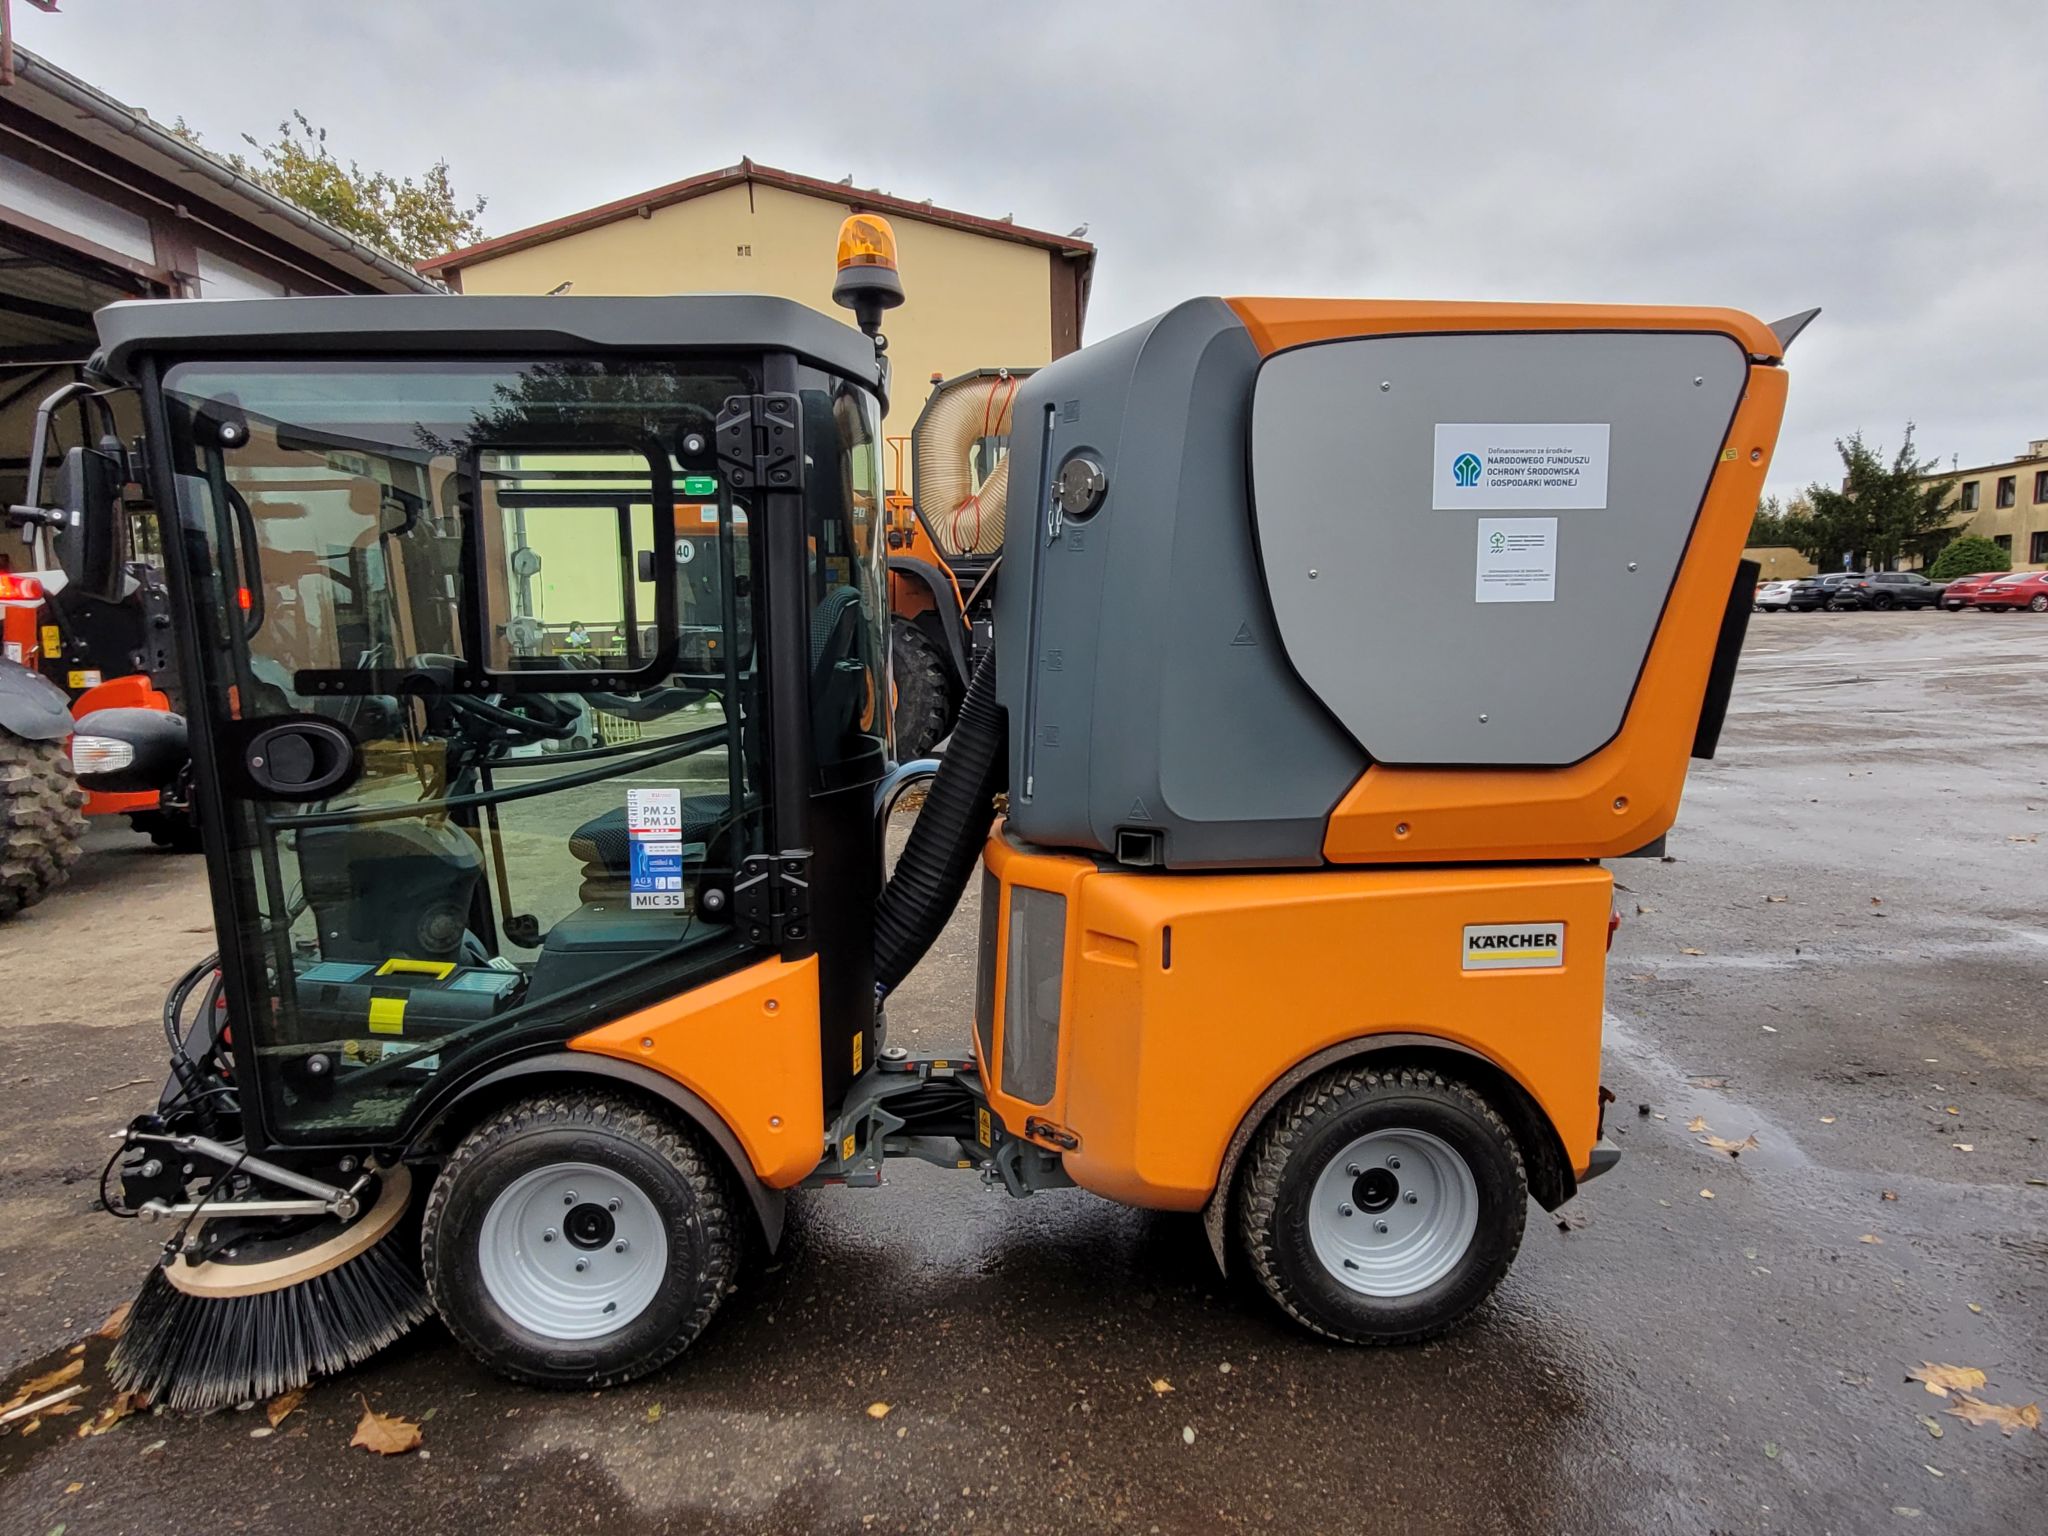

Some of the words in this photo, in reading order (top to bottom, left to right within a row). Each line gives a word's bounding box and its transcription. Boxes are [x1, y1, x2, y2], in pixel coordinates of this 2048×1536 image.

[1488, 447, 1537, 455] Dofinansowano
[1545, 447, 1573, 455] środków
[1487, 456, 1545, 465] NARODOWEGO
[1546, 456, 1590, 464] FUNDUSZU
[1487, 467, 1526, 476] OCHRONY
[1526, 465, 1580, 476] ŚRODOWISKA
[1490, 478, 1542, 487] GOSPODARKI
[1543, 478, 1578, 487] WODNEJ
[676, 544, 690, 558] 40
[643, 806, 661, 816] PM
[643, 816, 662, 827] PM
[663, 816, 677, 826] 10
[635, 895, 661, 906] MIC
[663, 895, 680, 906] 35
[1469, 933, 1558, 950] KÄRCHER
